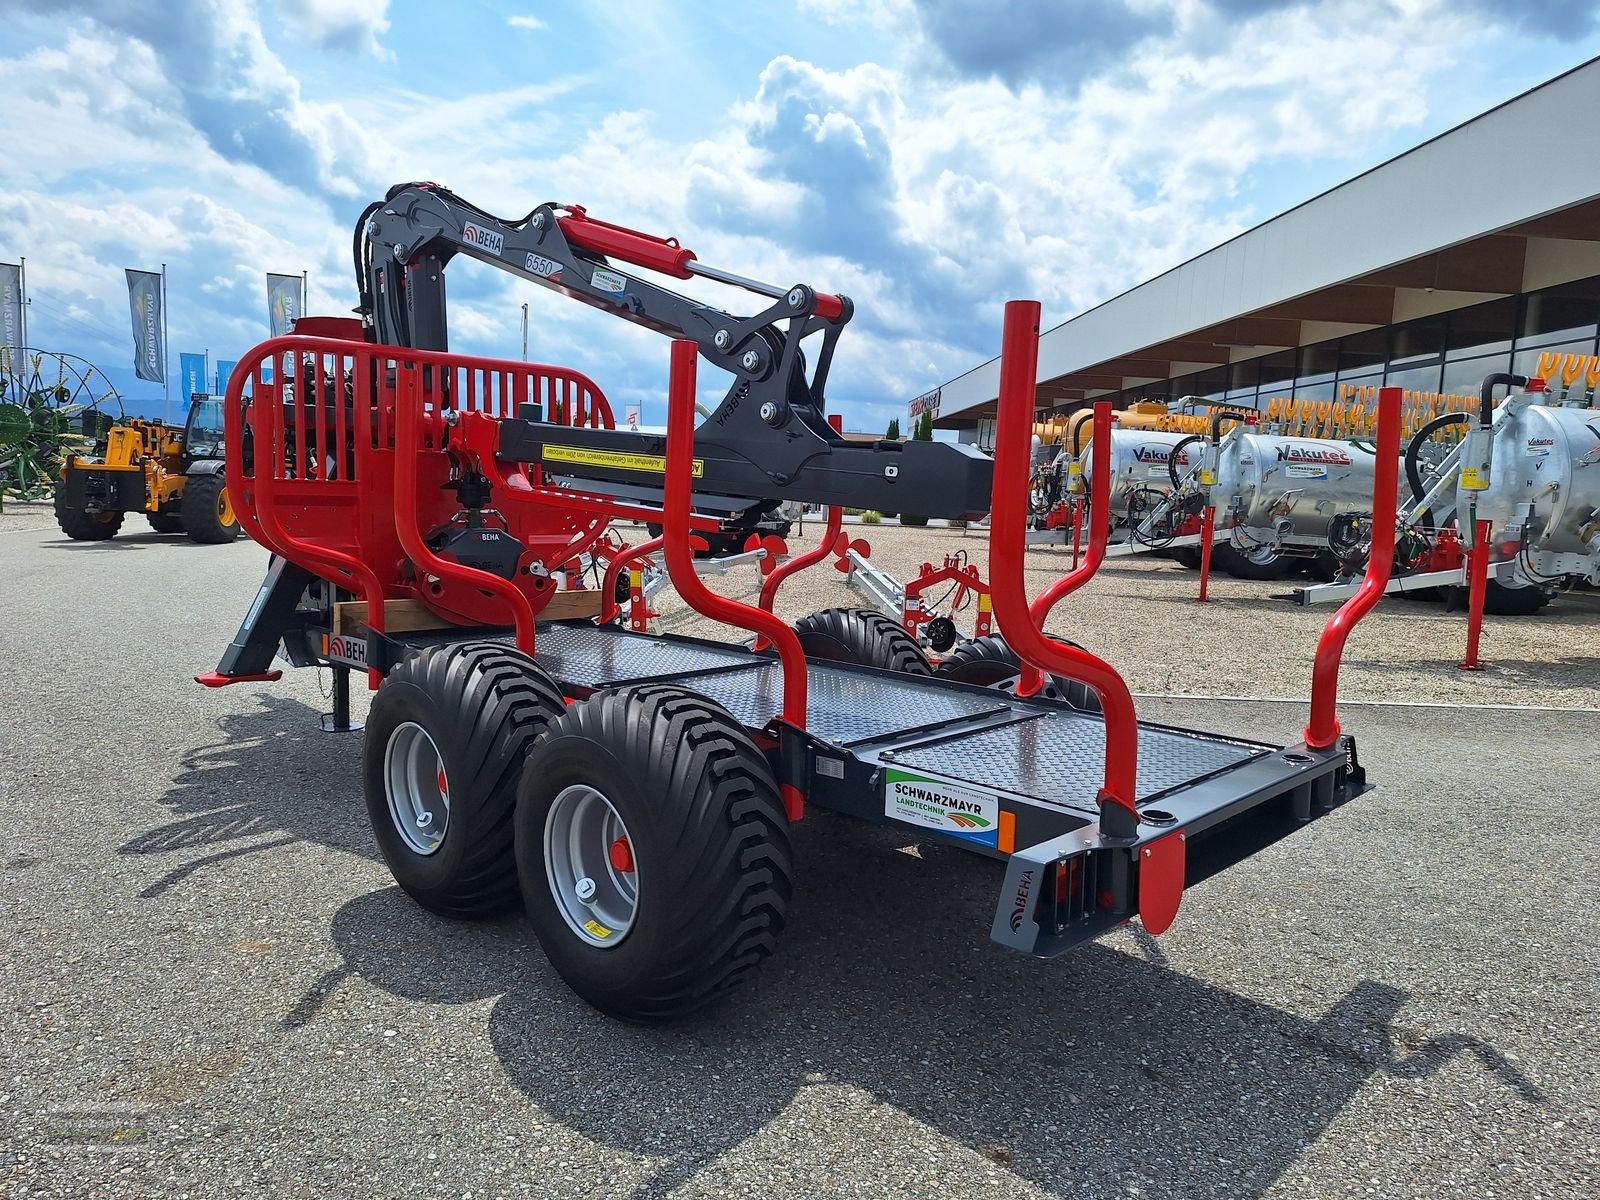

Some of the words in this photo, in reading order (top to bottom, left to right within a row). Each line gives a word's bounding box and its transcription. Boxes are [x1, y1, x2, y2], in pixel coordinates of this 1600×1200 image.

[478, 230, 503, 254] BEHA
[526, 254, 553, 276] 6550
[1133, 447, 1188, 462] Vakuec
[1275, 445, 1349, 461] Vakutec
[481, 533, 500, 541] BEHA
[895, 783, 982, 816] SCHWARZMAYR
[896, 796, 946, 816] LANDTECHNIK
[1014, 870, 1034, 908] BEHA
